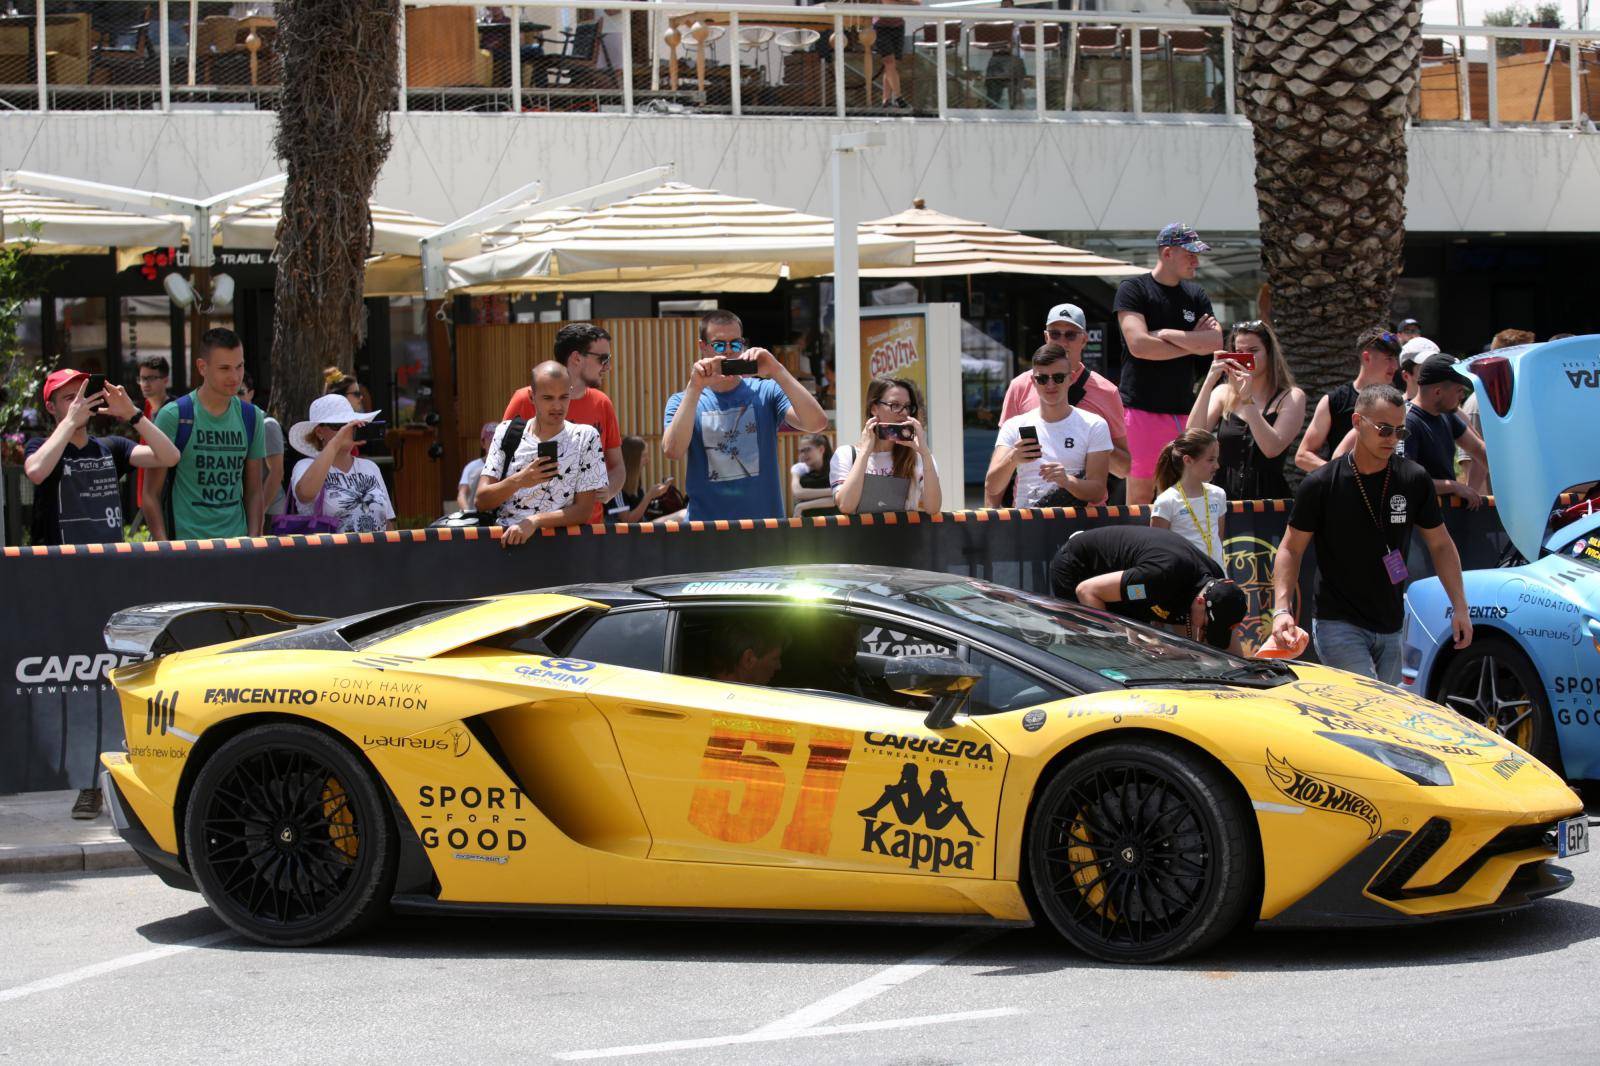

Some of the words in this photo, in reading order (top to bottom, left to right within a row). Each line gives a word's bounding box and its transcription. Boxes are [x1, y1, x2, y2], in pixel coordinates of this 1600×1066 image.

[221, 254, 264, 264] TRAVEL
[196, 429, 244, 446] DENIM
[195, 454, 245, 470] BRAND
[1390, 515, 1406, 524] CREW
[1518, 593, 1582, 615] FOUNDATION
[514, 666, 590, 686] GEMINI
[16, 685, 89, 695] EYEWEAR
[333, 678, 373, 691] TONY
[379, 681, 424, 695] HAWK
[203, 688, 318, 706] FANCENTRO
[320, 691, 428, 711] FOUNDATION
[152, 748, 169, 758] new
[170, 746, 187, 759] look
[863, 730, 994, 762] CARRERA
[863, 747, 917, 759] EYEWEAR
[925, 756, 959, 766] SINCE
[687, 713, 855, 857] 51
[419, 785, 527, 809] SPORT
[446, 813, 500, 824] FOR
[420, 827, 527, 851] GOOD
[861, 817, 975, 873] Kappa
[1567, 822, 1584, 851] GP
